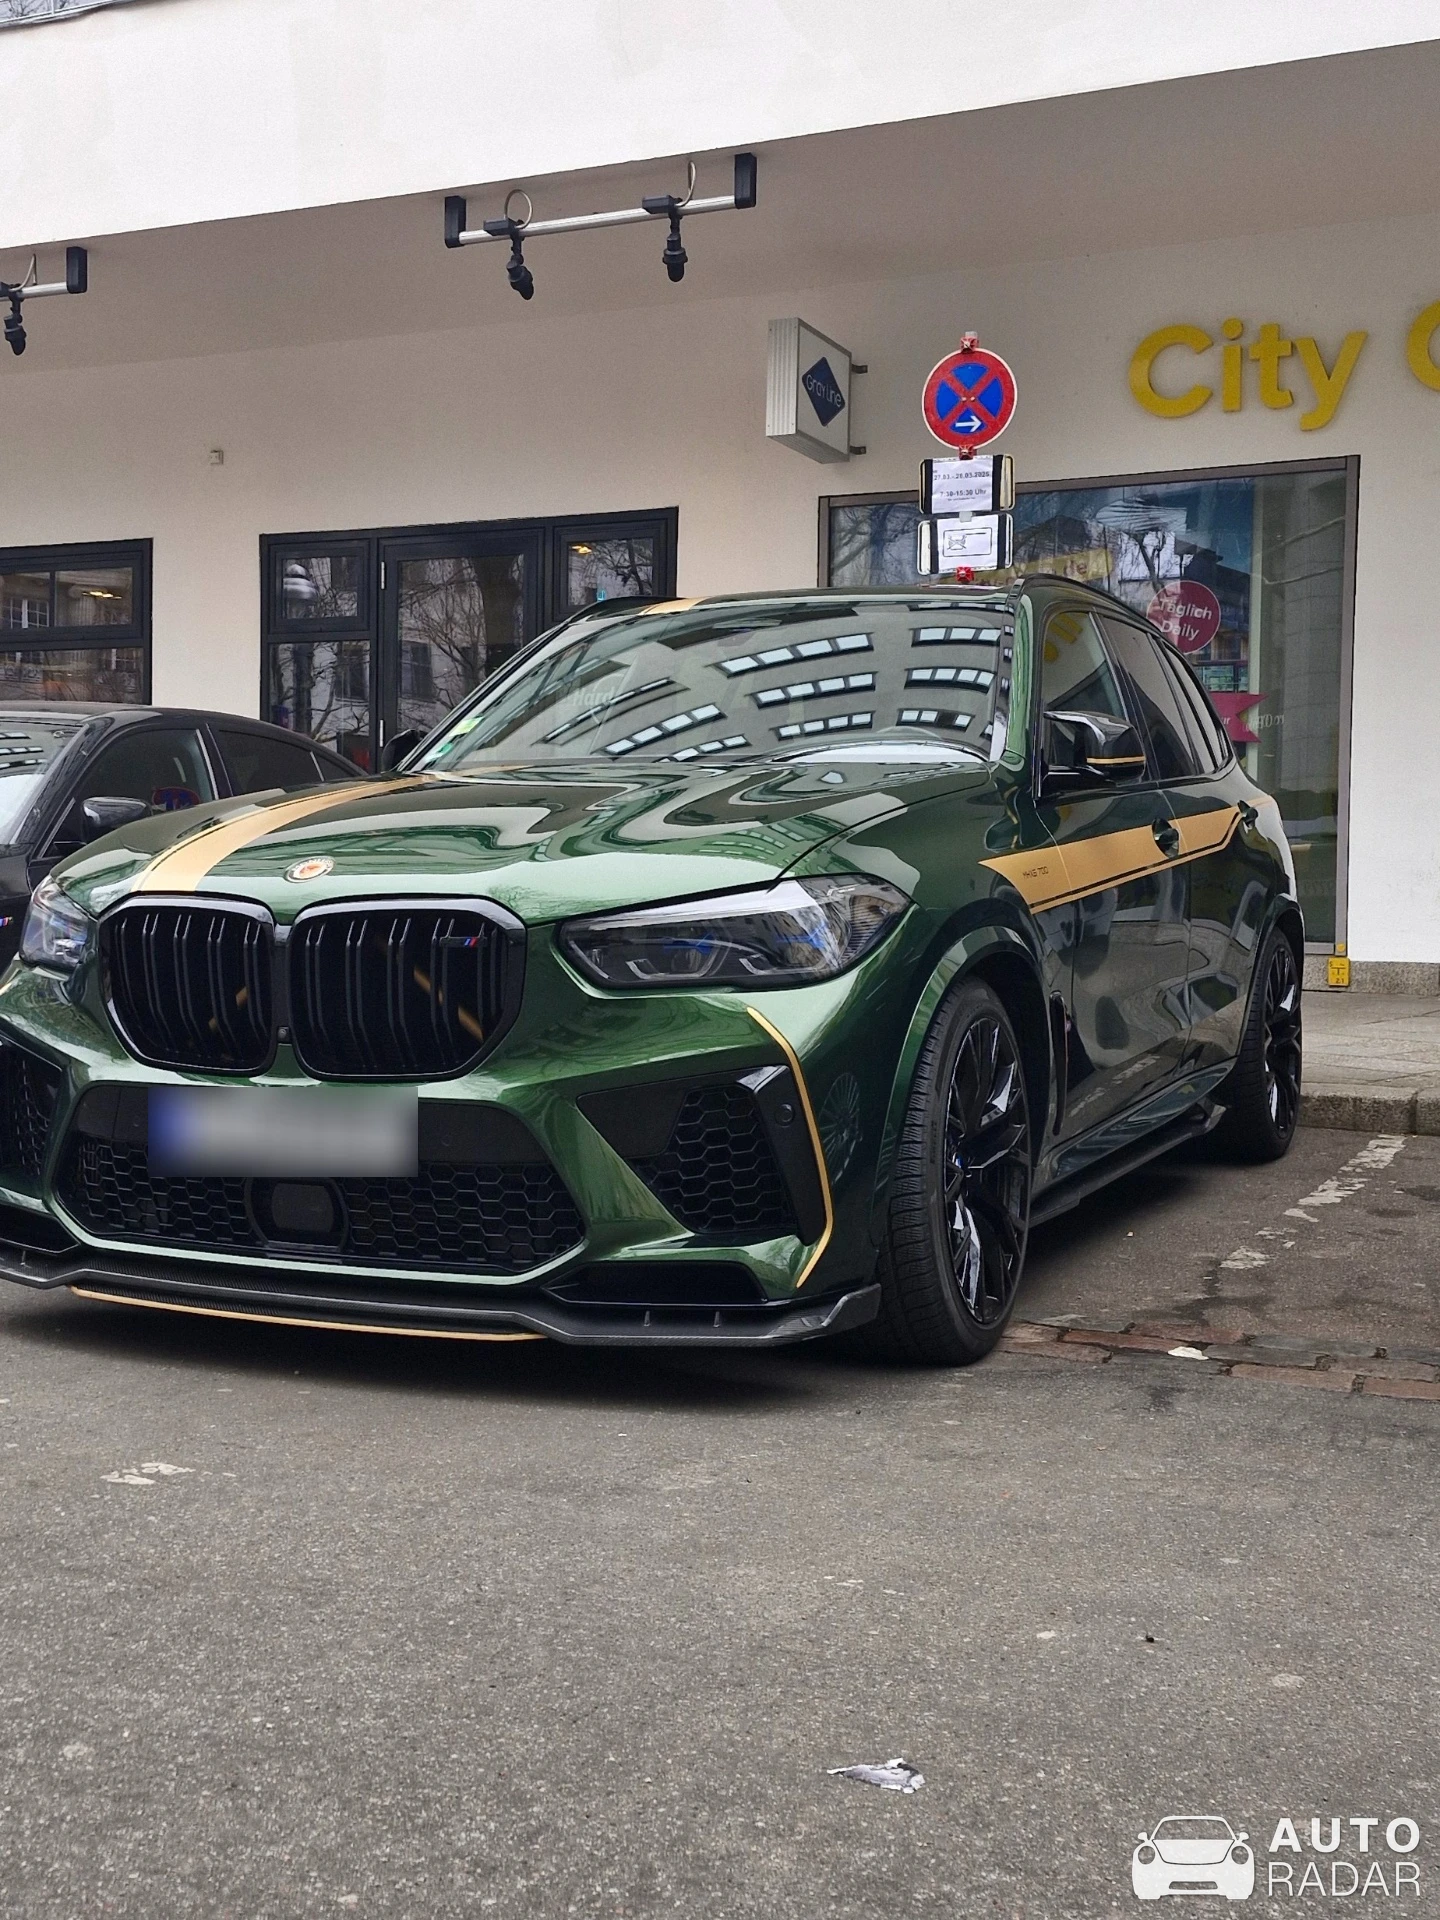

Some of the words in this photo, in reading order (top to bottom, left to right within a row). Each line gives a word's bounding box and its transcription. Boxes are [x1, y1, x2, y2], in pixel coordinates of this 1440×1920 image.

[1128, 317, 1370, 432] City
[1160, 598, 1212, 620] Täglich
[1160, 620, 1200, 641] Daily
